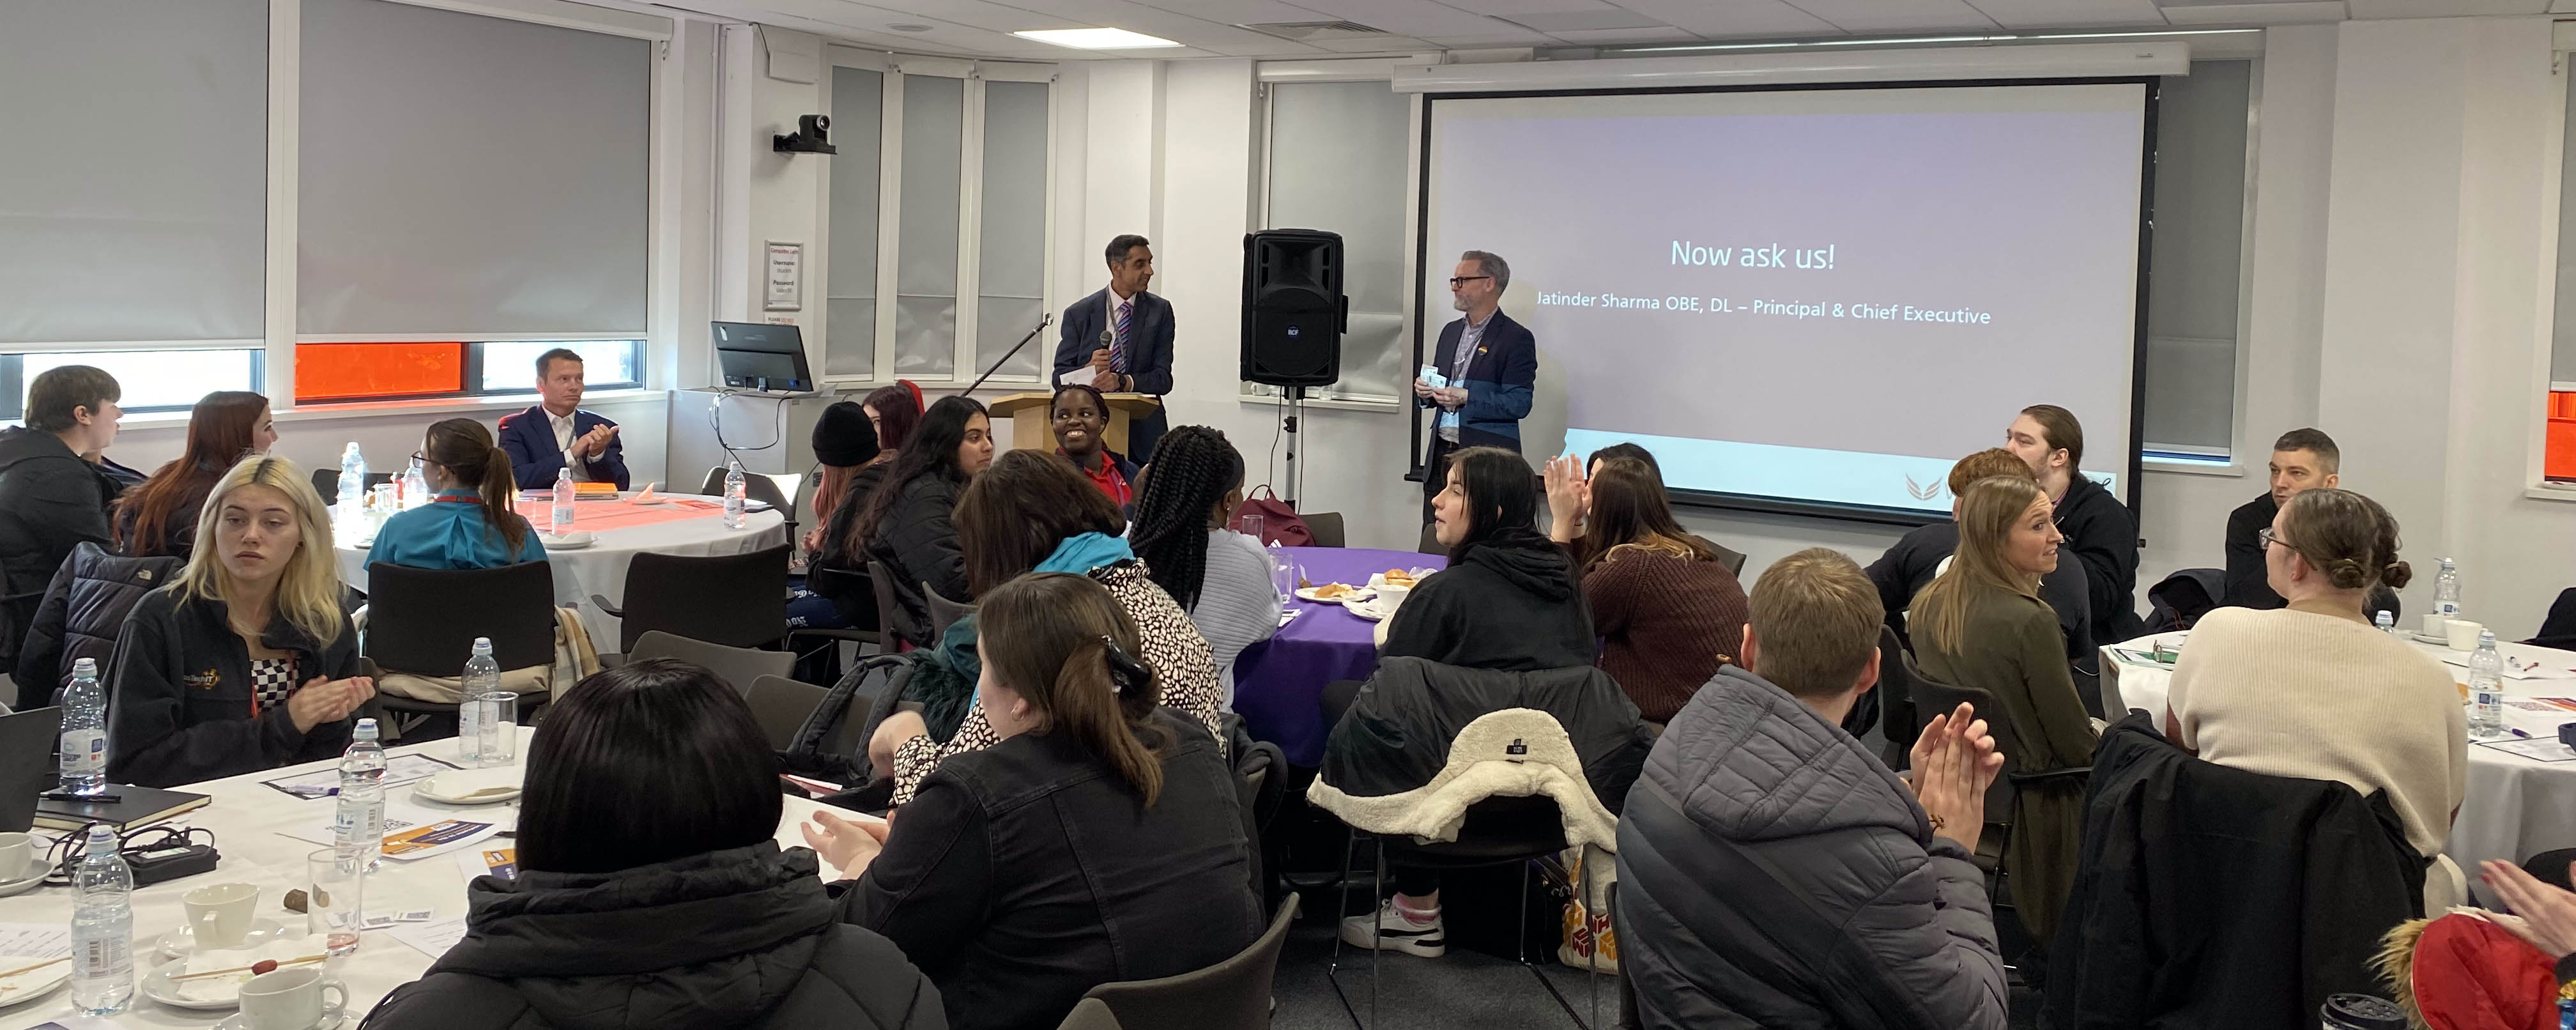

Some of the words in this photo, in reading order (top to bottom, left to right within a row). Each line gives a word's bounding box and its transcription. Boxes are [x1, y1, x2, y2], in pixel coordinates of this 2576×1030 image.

[1671, 240, 1731, 266] Now
[1740, 243, 1786, 268] ask
[1795, 244, 1834, 269] us!
[1537, 291, 1597, 307] Jatinder
[1601, 294, 1660, 309] Sharma
[1666, 296, 1704, 314] OBE,
[1710, 298, 1733, 312] DL
[1754, 299, 1825, 319] Principal
[1832, 303, 1844, 318] &
[1851, 304, 1898, 320] Chief
[1904, 305, 1991, 324] Executive
